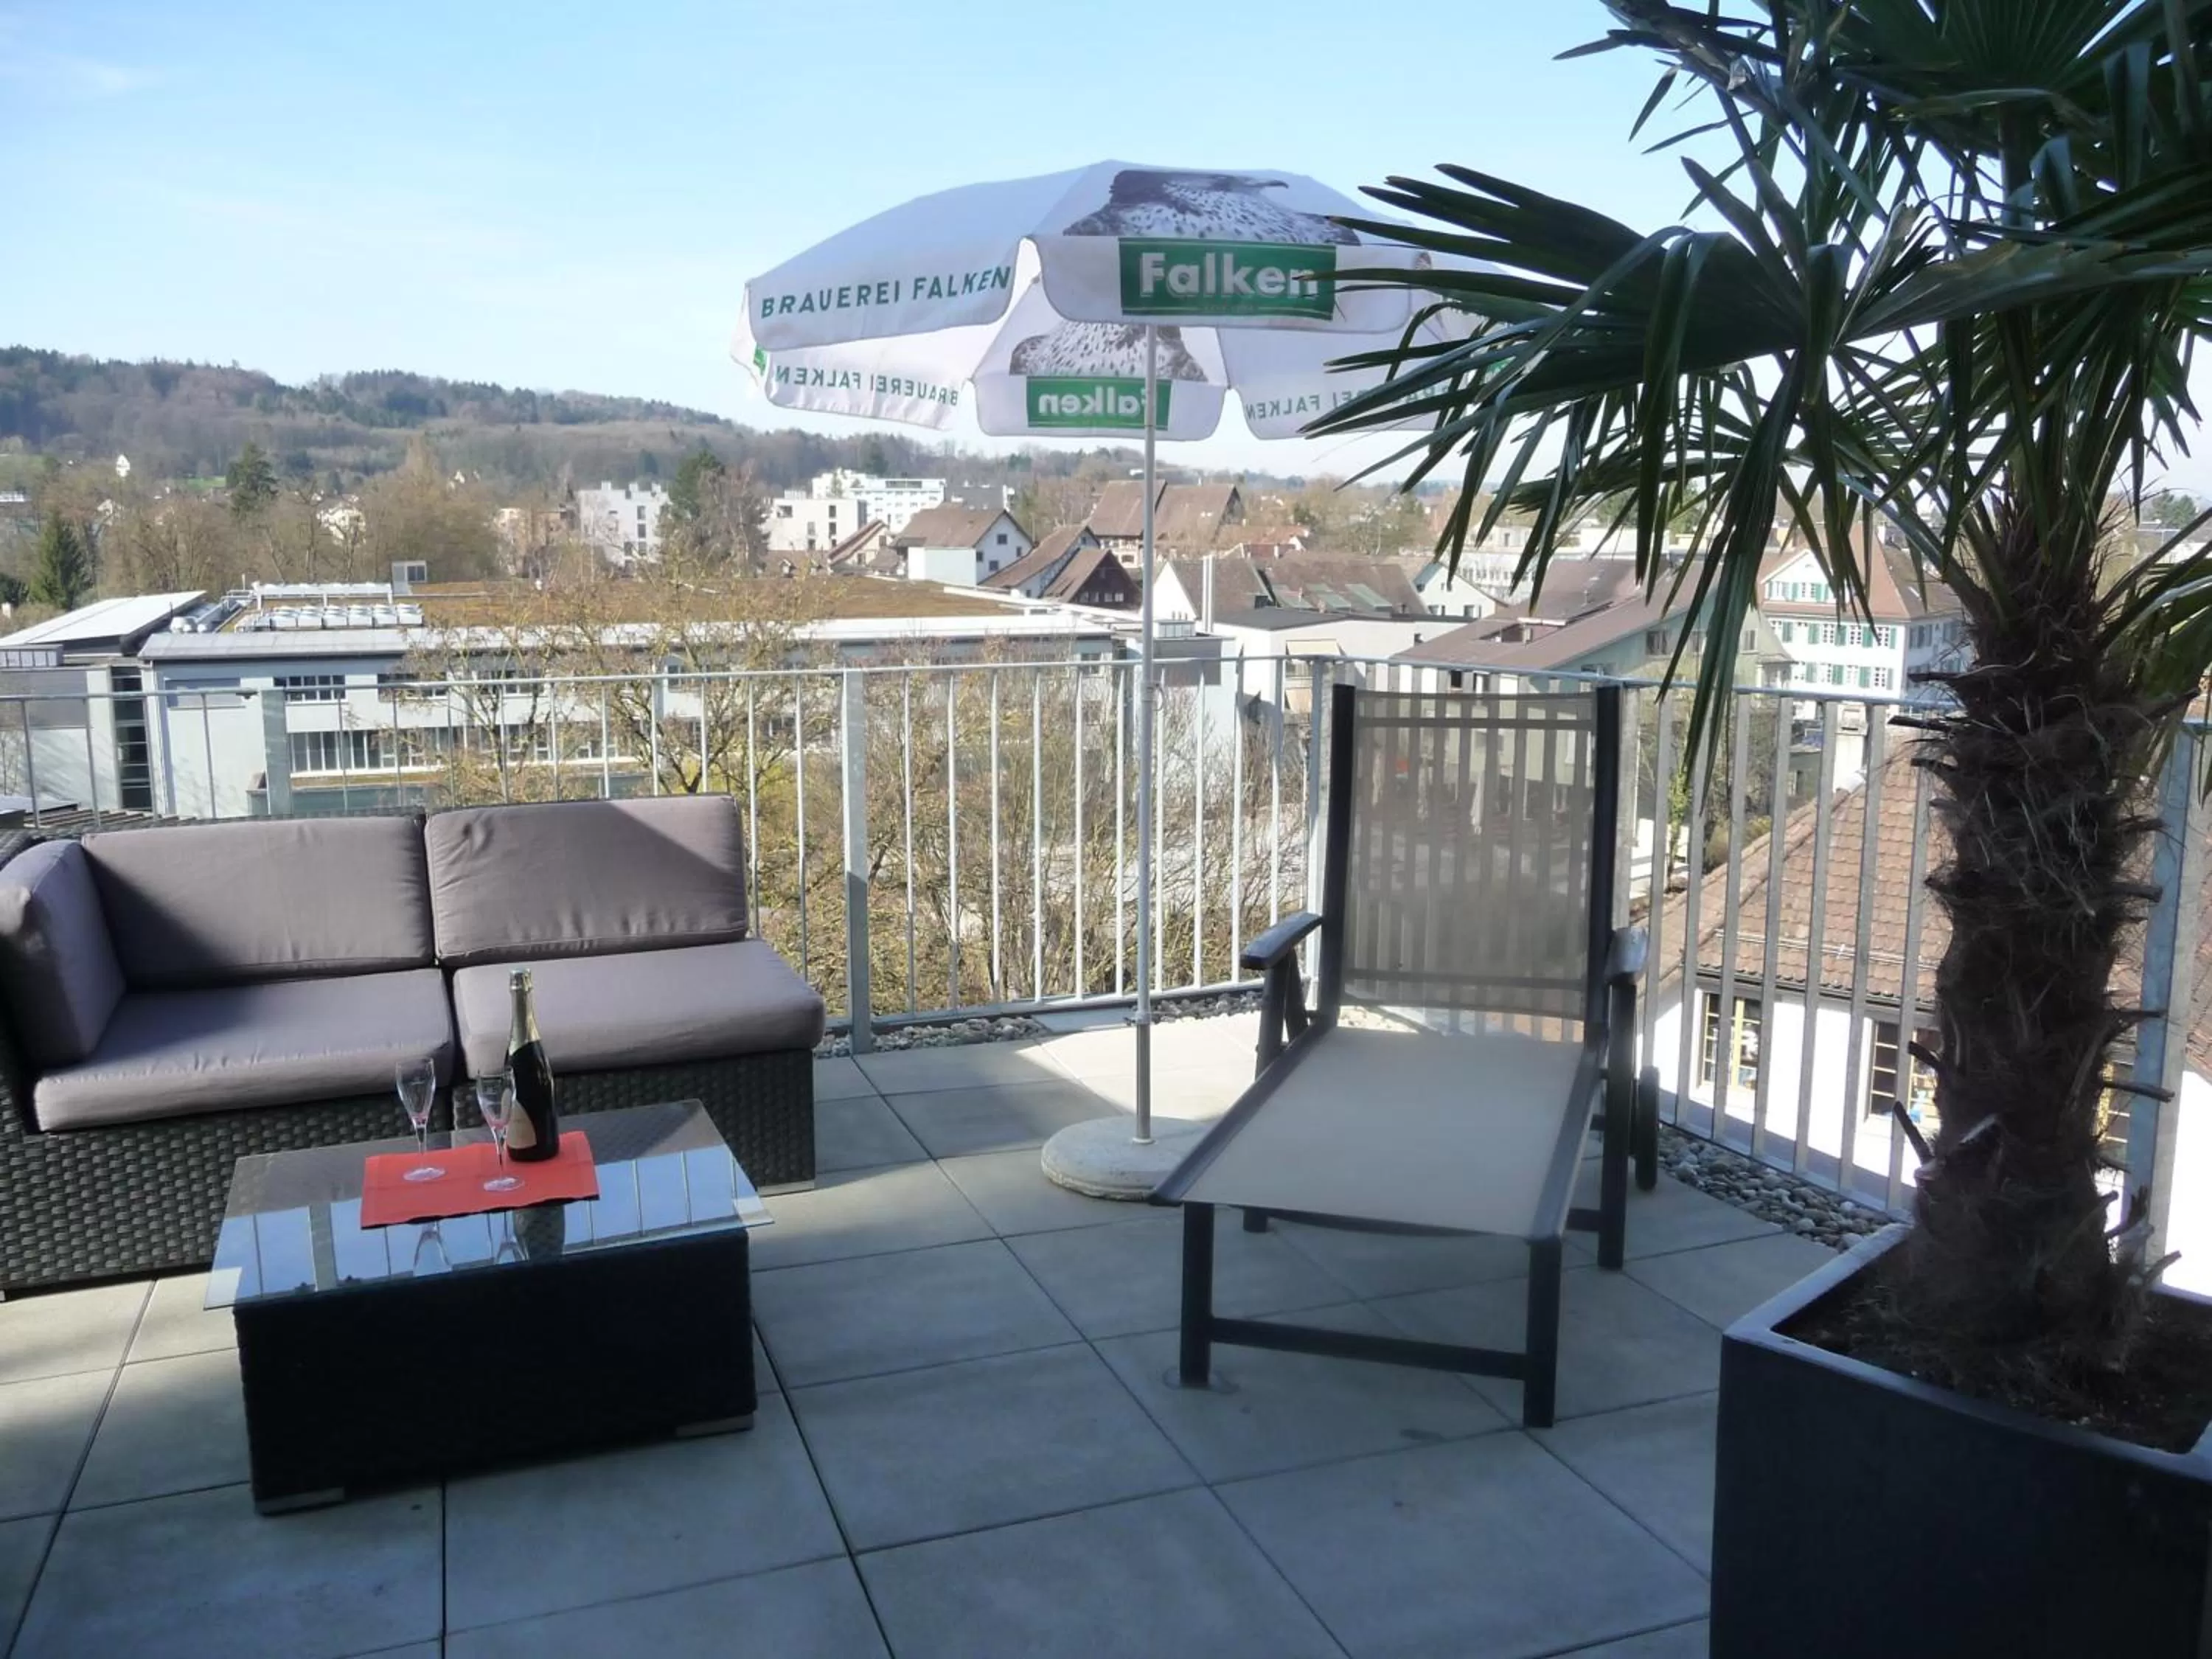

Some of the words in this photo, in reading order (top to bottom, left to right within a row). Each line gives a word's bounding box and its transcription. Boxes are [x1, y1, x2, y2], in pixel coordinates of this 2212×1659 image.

[761, 279, 900, 319] BRAUEREI
[913, 265, 1011, 301] FALKEN
[1139, 251, 1318, 299] Falken
